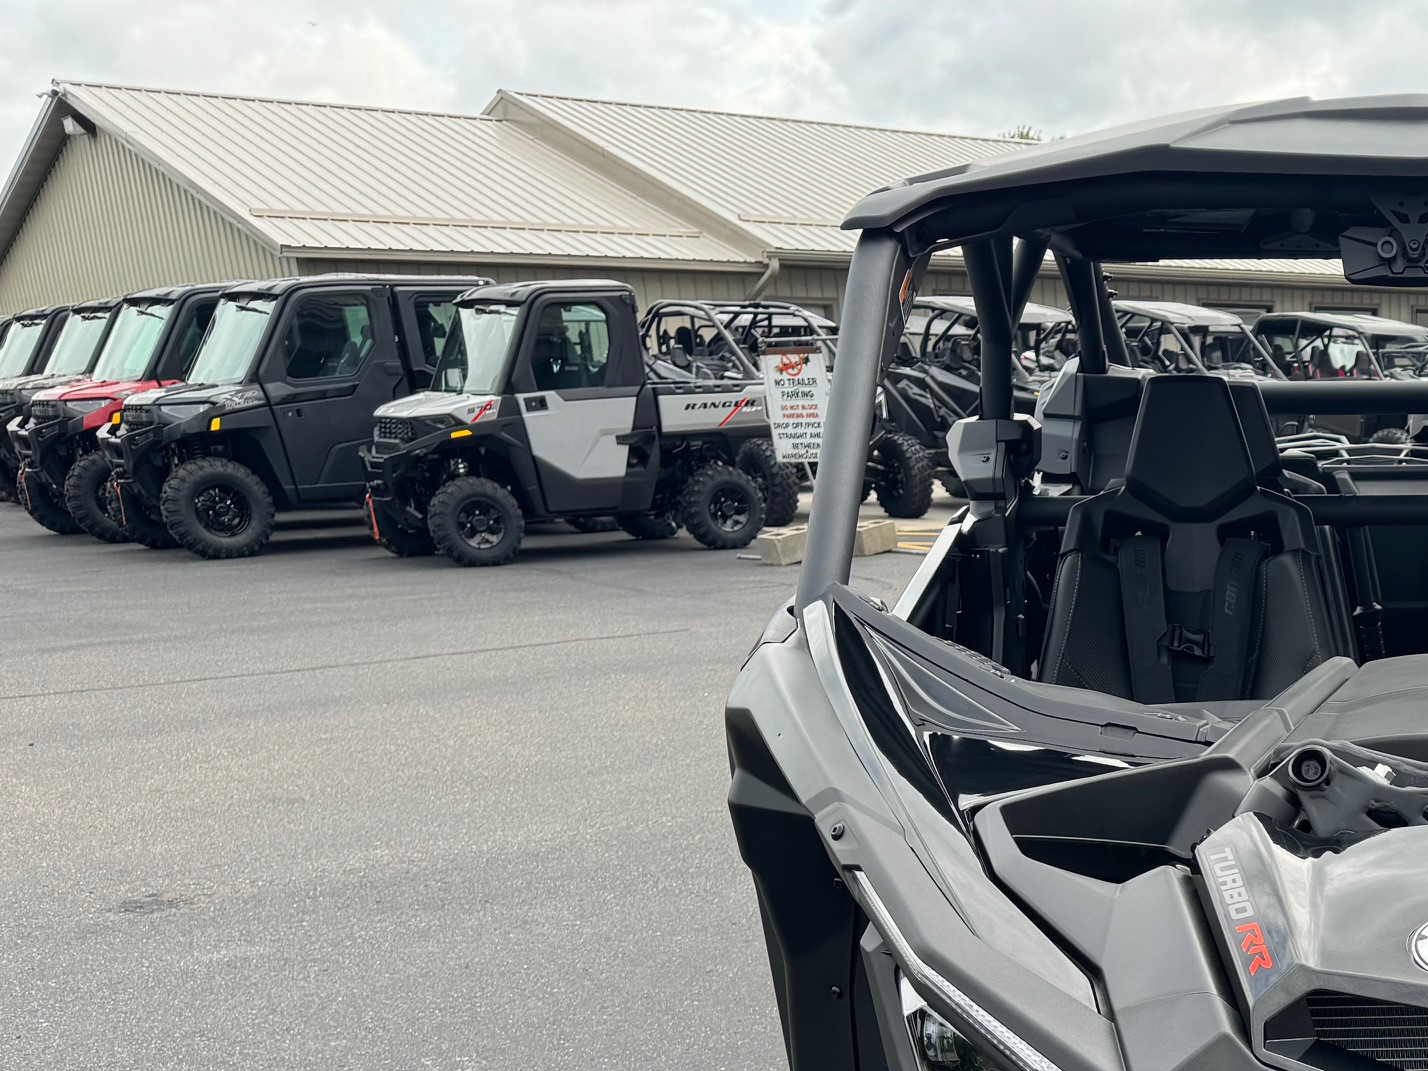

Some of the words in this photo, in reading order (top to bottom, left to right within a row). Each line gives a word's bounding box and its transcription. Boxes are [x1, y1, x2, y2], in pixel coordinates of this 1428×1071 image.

[774, 378, 786, 386] NO
[787, 377, 818, 386] TRAILER
[781, 390, 815, 399] PARKING
[684, 399, 757, 411] RANGER
[1209, 847, 1255, 920] TURBO
[1235, 922, 1274, 976] RR
